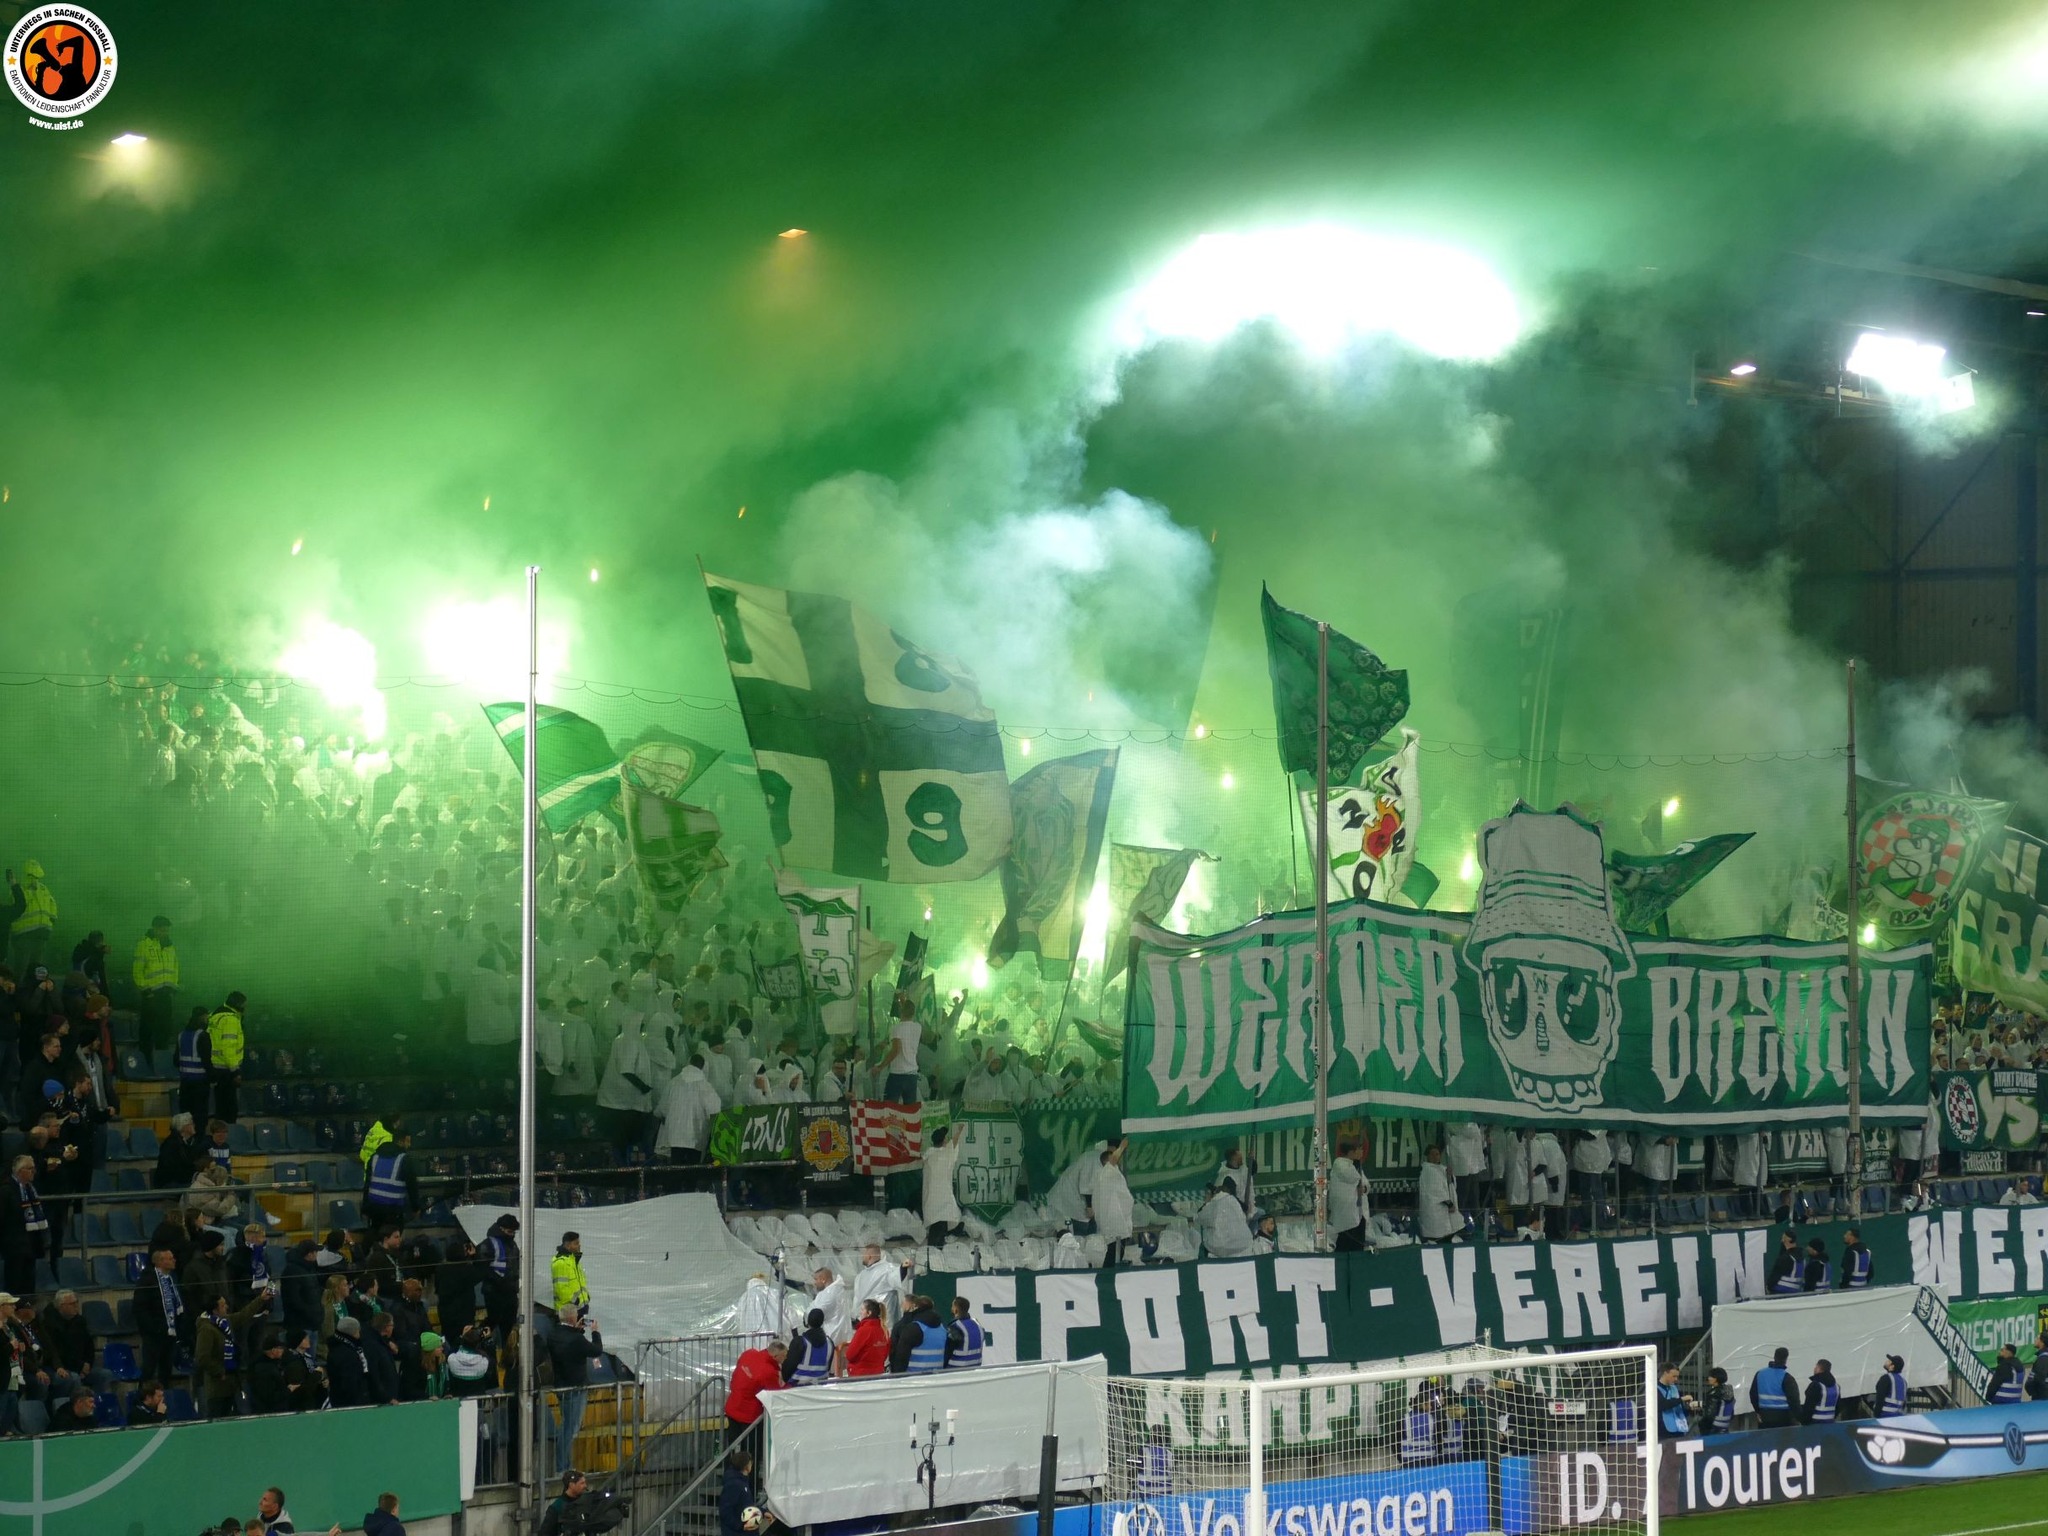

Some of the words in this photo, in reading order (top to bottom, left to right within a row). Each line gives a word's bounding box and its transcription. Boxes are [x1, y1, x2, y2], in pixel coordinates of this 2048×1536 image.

[1889, 892, 1952, 927] BOYS
[1146, 930, 1465, 1106] WERDER
[1646, 965, 1914, 1105] BREMEN
[958, 1164, 1020, 1206] CREW
[1559, 1451, 1622, 1525] ID.
[1676, 1439, 1822, 1509] Tourer
[1180, 1485, 1454, 1536] Volkswagen
